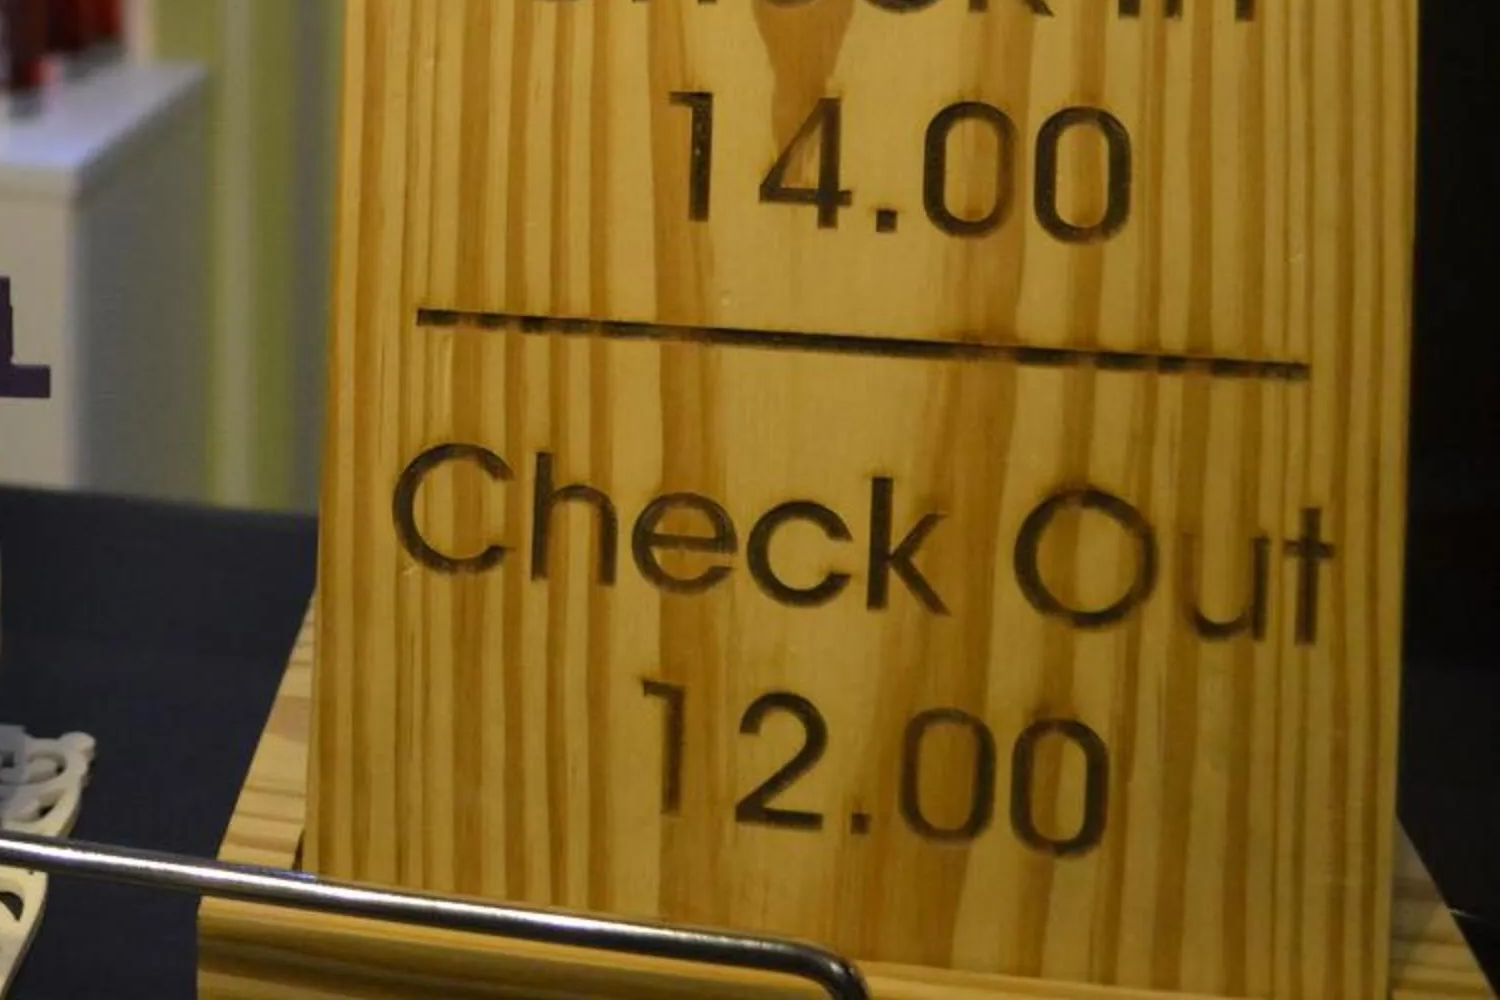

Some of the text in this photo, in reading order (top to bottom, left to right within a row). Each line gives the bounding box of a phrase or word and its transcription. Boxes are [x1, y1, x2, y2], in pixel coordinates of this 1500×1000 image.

[669, 90, 1133, 244] 14.00
[391, 441, 1337, 646] Check Out
[641, 679, 1111, 858] 12.00
